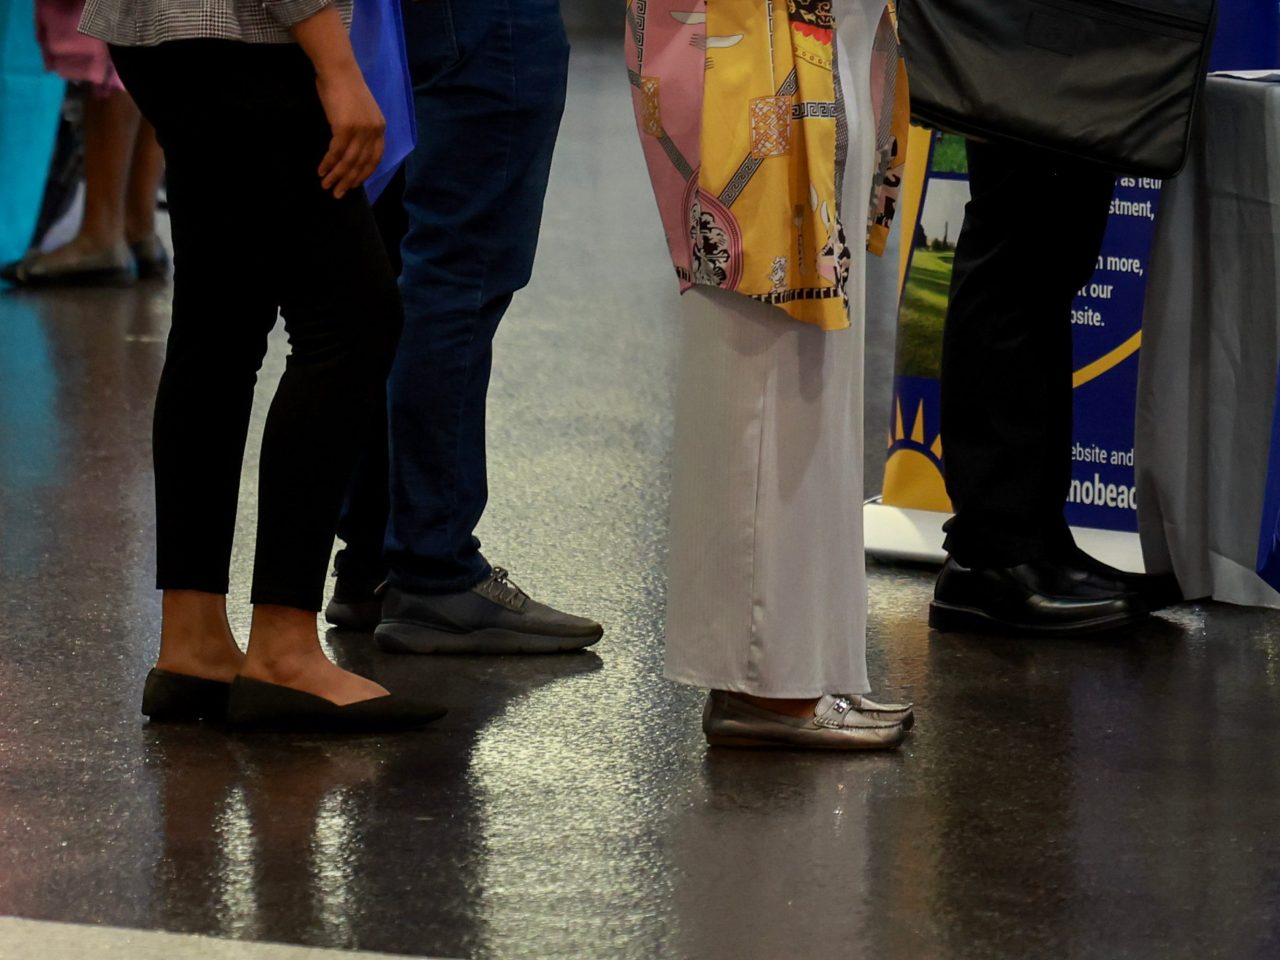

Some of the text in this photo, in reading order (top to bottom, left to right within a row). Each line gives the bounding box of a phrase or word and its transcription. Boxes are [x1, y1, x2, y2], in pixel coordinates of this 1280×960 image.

[1107, 257, 1144, 276] more,
[1090, 284, 1113, 299] our
[1110, 448, 1134, 466] and
[1066, 473, 1137, 510] nobeac
